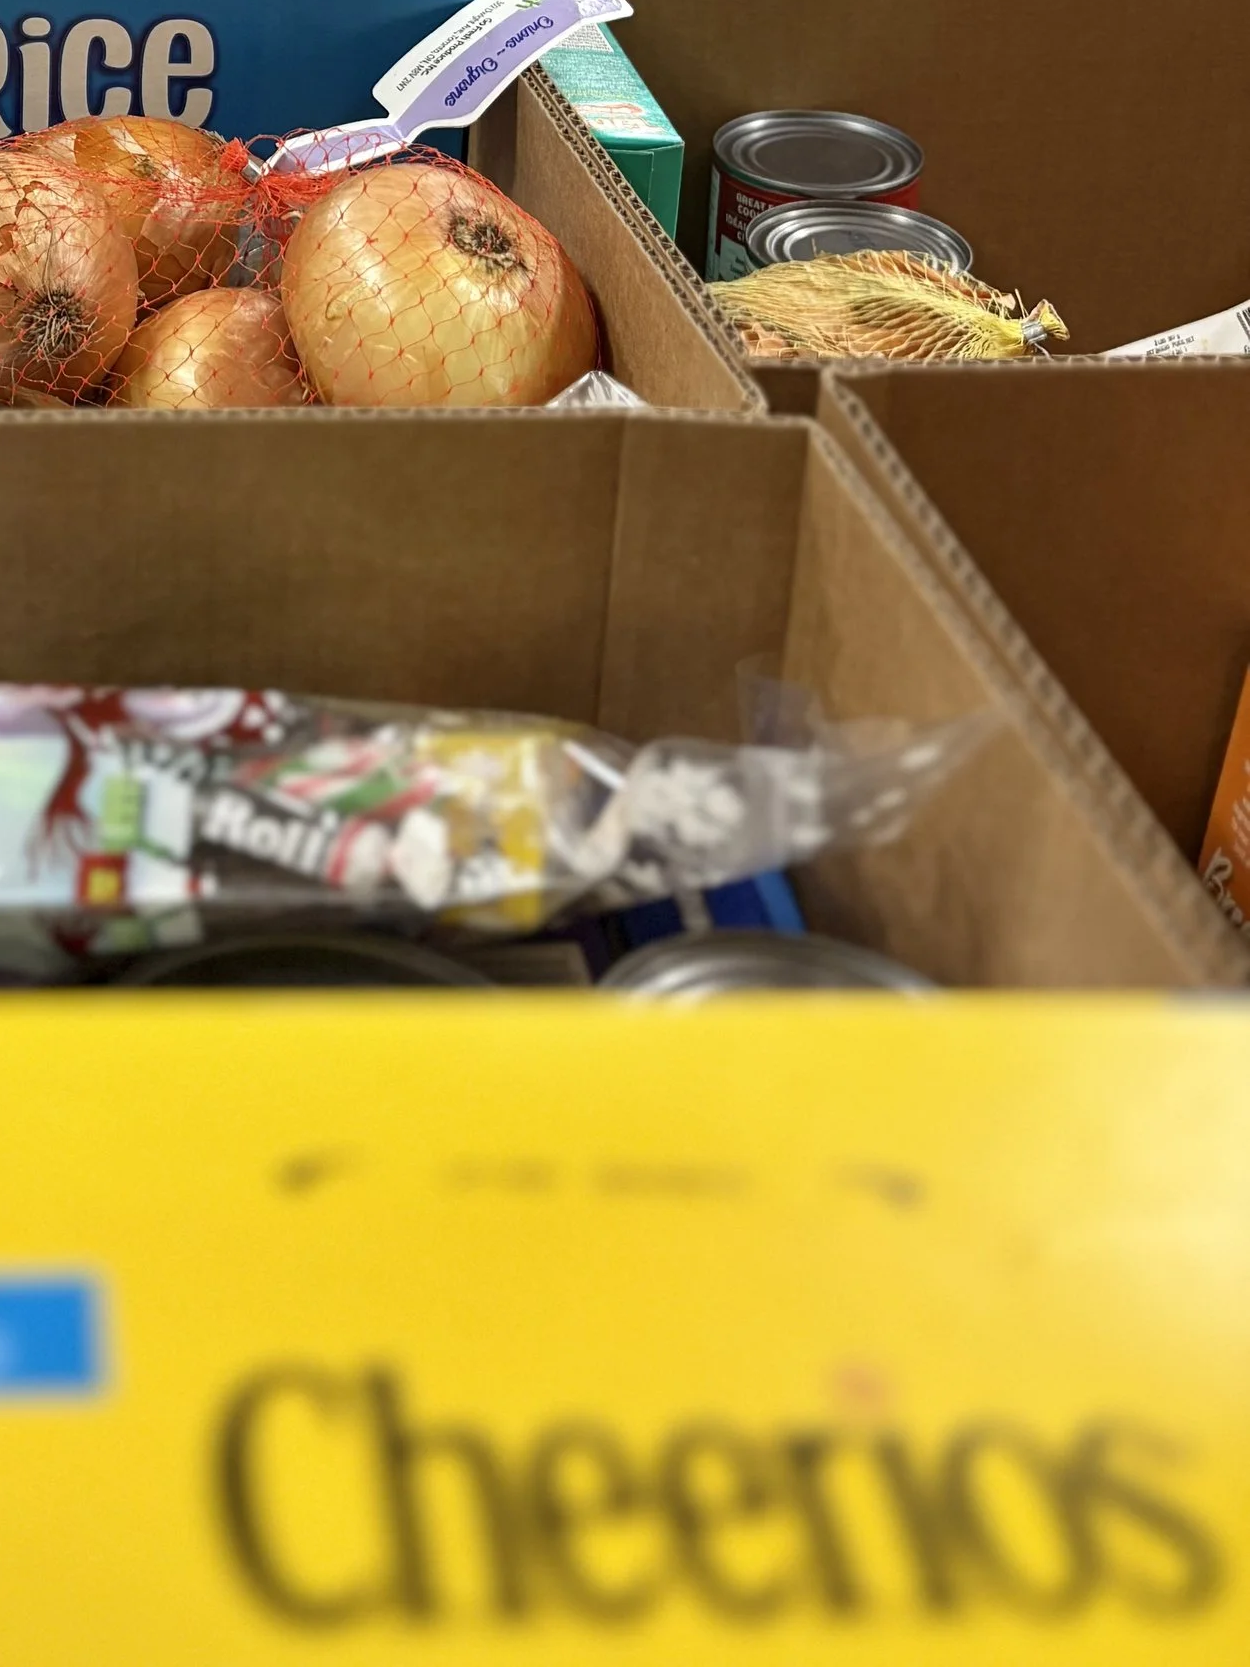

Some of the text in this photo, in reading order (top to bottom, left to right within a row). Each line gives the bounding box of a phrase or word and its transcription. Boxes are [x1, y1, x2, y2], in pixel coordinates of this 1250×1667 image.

[462, 23, 482, 41] Fresh
[478, 15, 492, 28] Go
[505, 15, 554, 48] Onions
[433, 38, 463, 65] Produce
[444, 56, 498, 107] Oignons
[207, 1360, 1224, 1632] Cheerios
